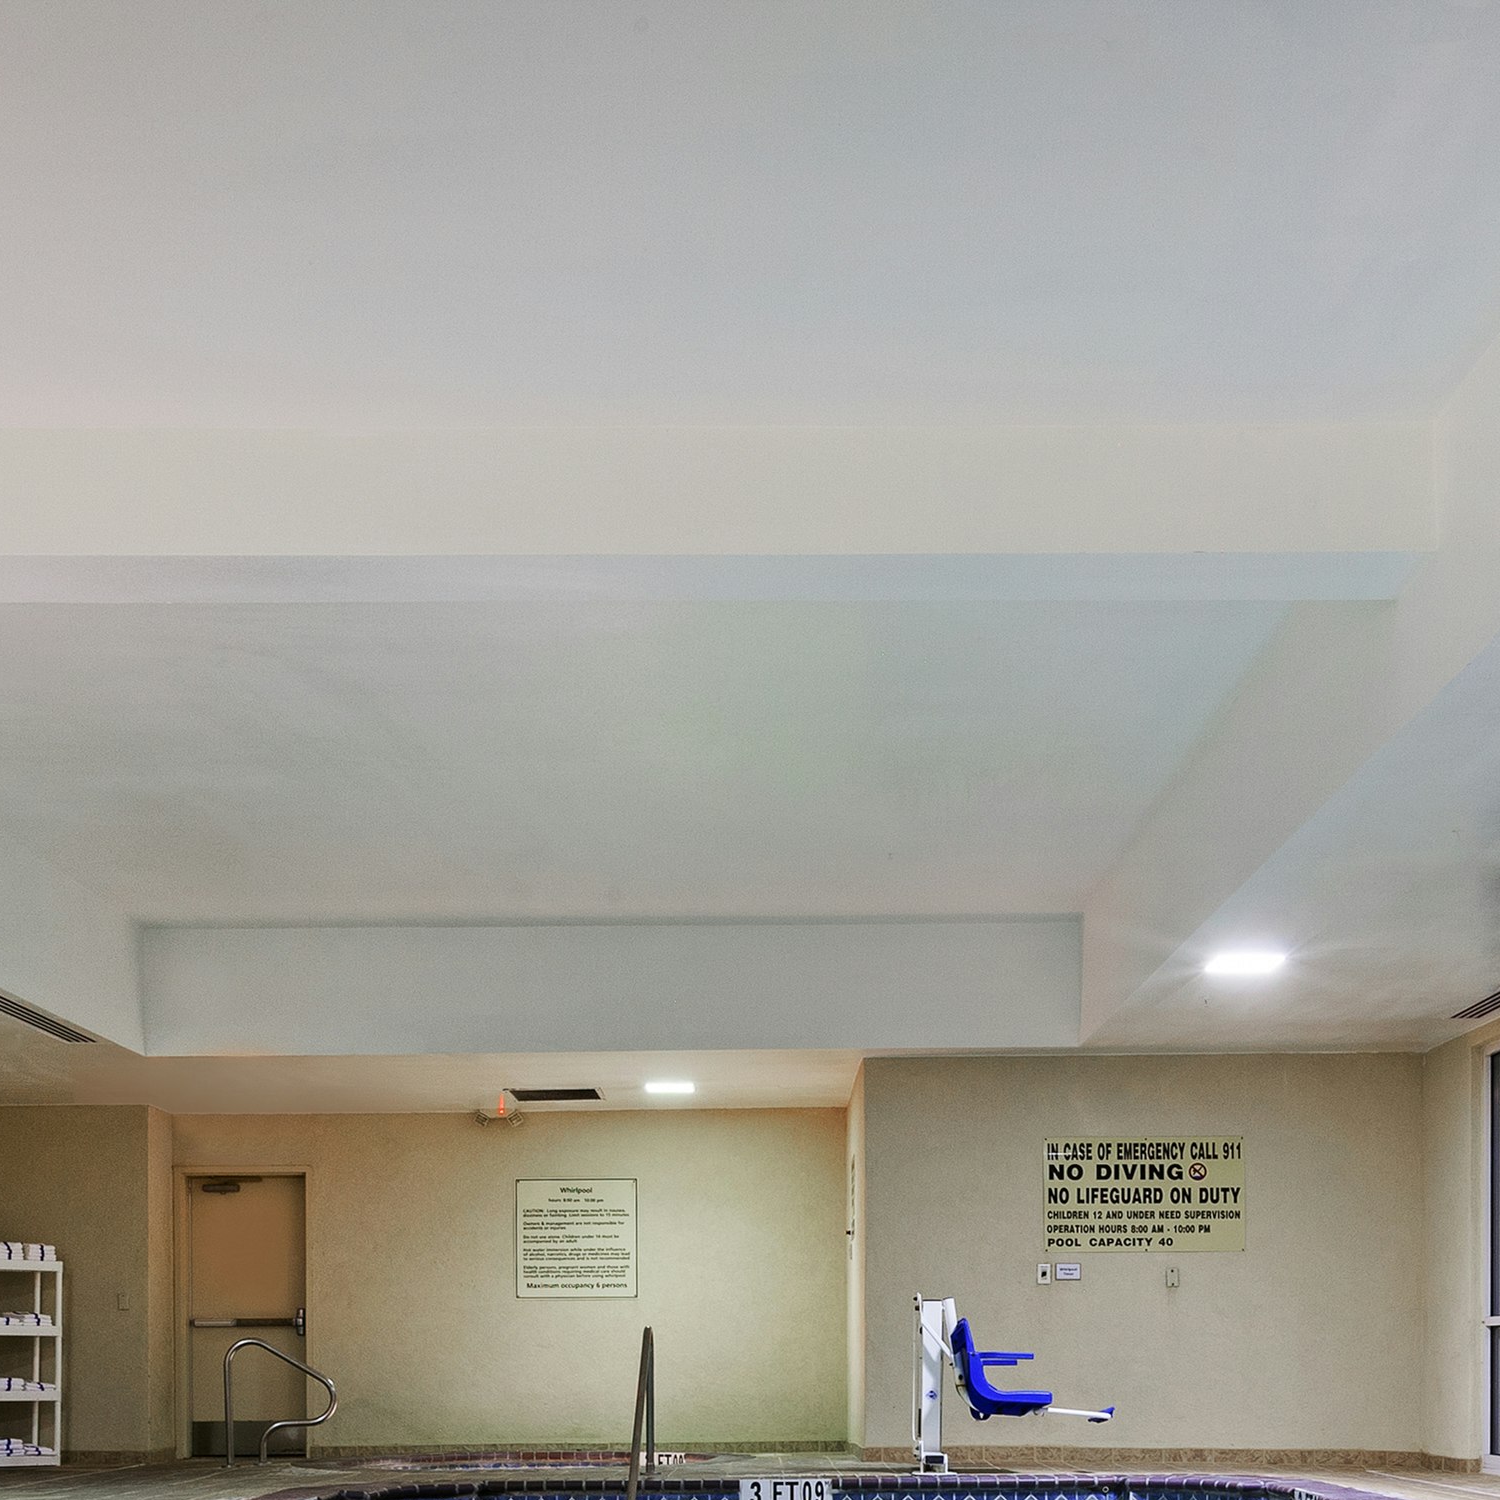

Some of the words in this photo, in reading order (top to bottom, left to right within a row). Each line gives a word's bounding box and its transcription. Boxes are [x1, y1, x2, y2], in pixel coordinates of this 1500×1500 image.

[1047, 1143, 1058, 1160] IN
[1064, 1143, 1092, 1160] CASE
[1098, 1143, 1112, 1160] OF
[1117, 1143, 1185, 1160] EMERGENCY
[1191, 1143, 1218, 1159] CALL
[1223, 1142, 1241, 1159] 911
[1049, 1164, 1083, 1180] NO
[1096, 1164, 1183, 1180] DIVING
[1048, 1188, 1069, 1204] NO
[1077, 1188, 1163, 1204] LIFEGUARD
[1170, 1188, 1191, 1203] ON
[1200, 1187, 1240, 1203] DUTY
[1047, 1211, 1089, 1219] CHILDREN
[1093, 1211, 1102, 1219] 12
[1106, 1211, 1123, 1219] AND
[1127, 1211, 1155, 1219] UNDER
[1159, 1211, 1181, 1219] NEED
[1184, 1211, 1240, 1219] SUPERVISION
[1047, 1225, 1095, 1233] OPERATION
[1099, 1225, 1127, 1233] HOURS
[1131, 1225, 1148, 1233] 8:00
[1151, 1225, 1164, 1233] AM
[1174, 1225, 1195, 1233] 10:00
[1199, 1225, 1210, 1233] PM
[1048, 1239, 1081, 1247] POOL
[1089, 1238, 1153, 1247] CAPACITY
[1158, 1238, 1173, 1246] 40
